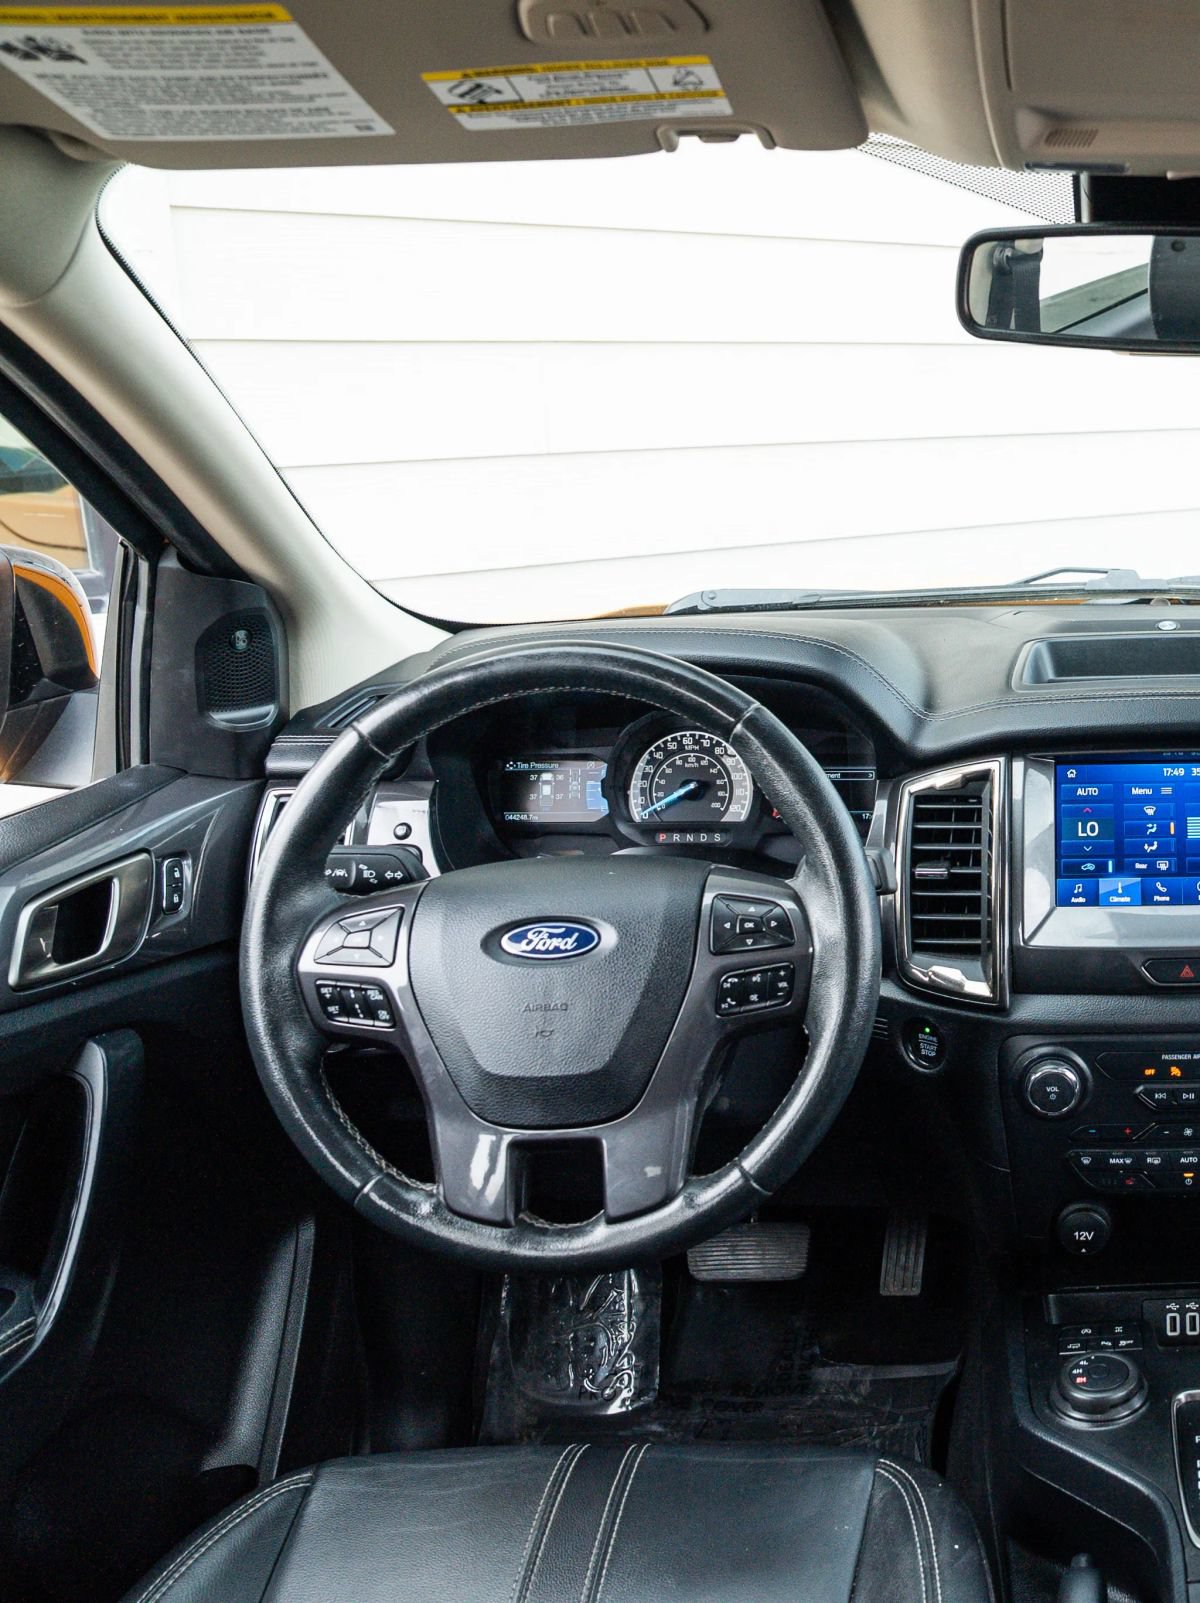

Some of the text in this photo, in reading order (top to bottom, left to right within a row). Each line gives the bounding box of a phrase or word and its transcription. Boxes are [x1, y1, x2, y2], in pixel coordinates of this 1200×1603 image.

[682, 737, 693, 745] 60
[700, 739, 710, 747] 70
[667, 742, 677, 750] 50
[714, 747, 724, 755] 80
[1163, 768, 1185, 777] 17:49
[1076, 787, 1099, 796] AUTO
[1132, 787, 1153, 795] Menu
[1077, 822, 1099, 837] LO
[659, 833, 721, 841] P R N D S
[1135, 862, 1148, 870] Rear
[1071, 895, 1086, 903] Audio
[1109, 894, 1130, 903] Climate
[520, 927, 578, 952] Ford
[522, 1003, 568, 1013] AIRBAG
[920, 1043, 937, 1051] START
[921, 1049, 936, 1057] STOP
[1144, 1068, 1156, 1076] OFF
[1073, 1231, 1095, 1241] 12V
